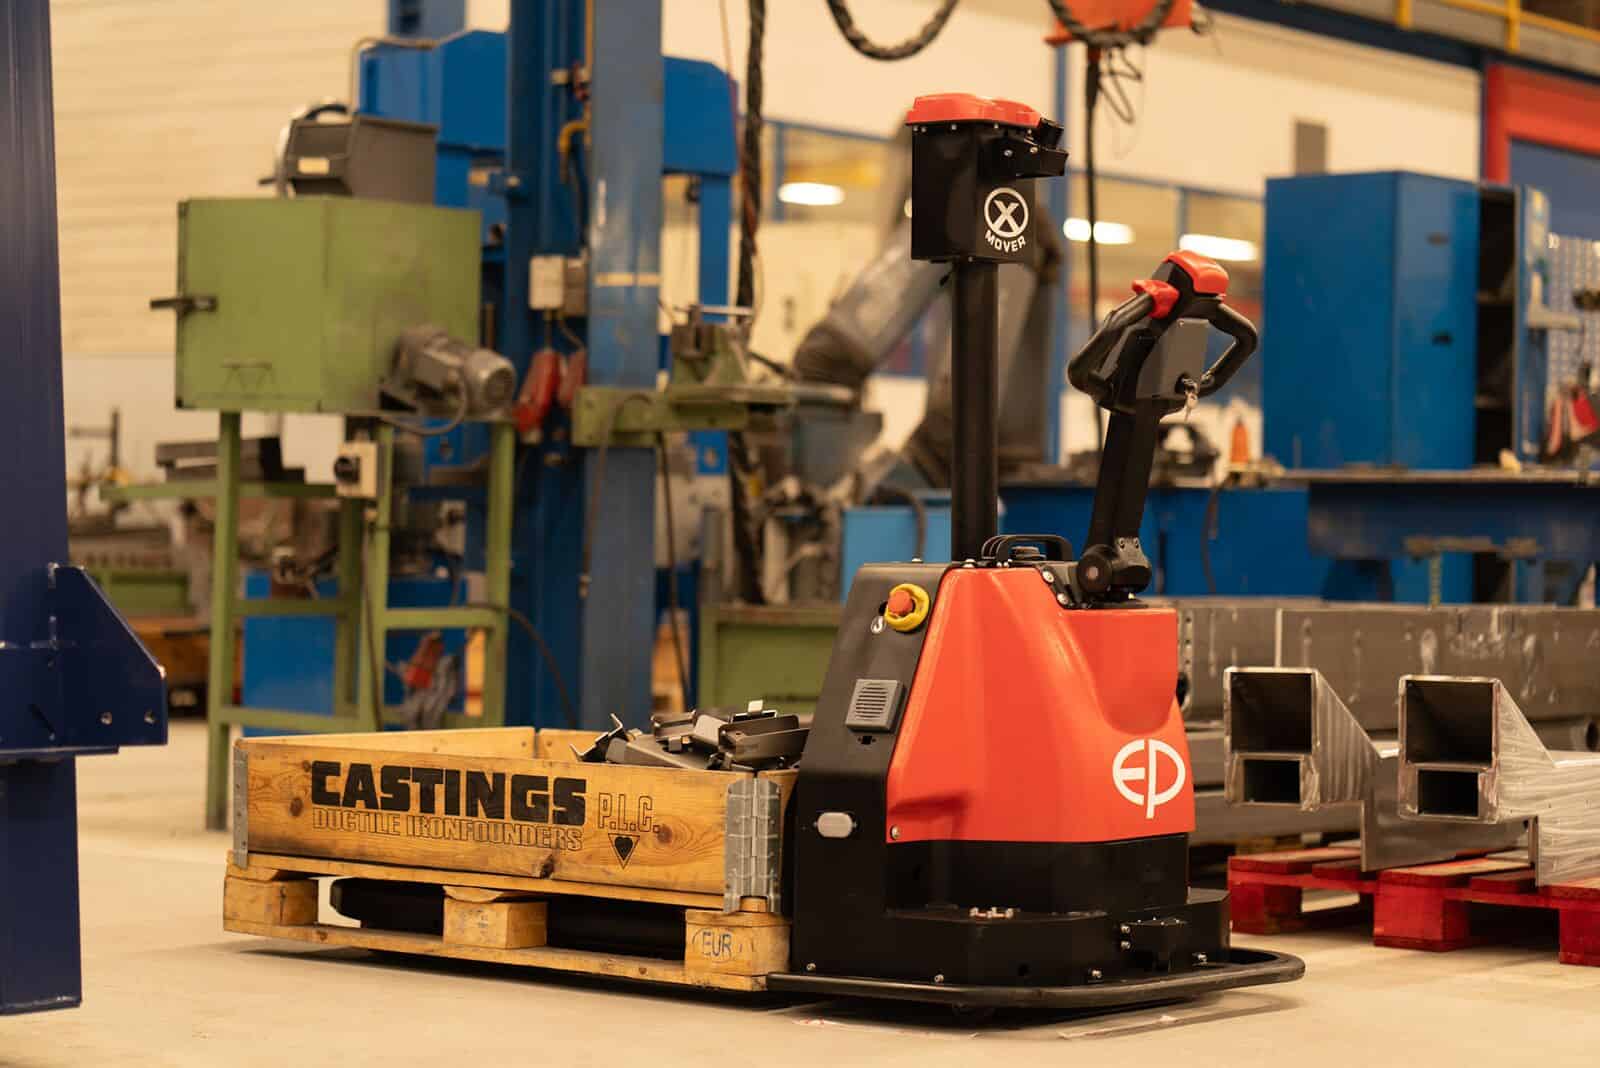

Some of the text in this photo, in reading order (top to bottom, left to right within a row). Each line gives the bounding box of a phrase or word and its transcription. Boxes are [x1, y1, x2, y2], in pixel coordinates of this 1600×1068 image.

[985, 229, 1026, 253] MOVER
[311, 760, 661, 833] CASTINGS P.L.C.
[1112, 738, 1186, 819] EP
[312, 807, 584, 851] DUCTILE IRONFOUNDERS
[702, 931, 732, 957] EUR
